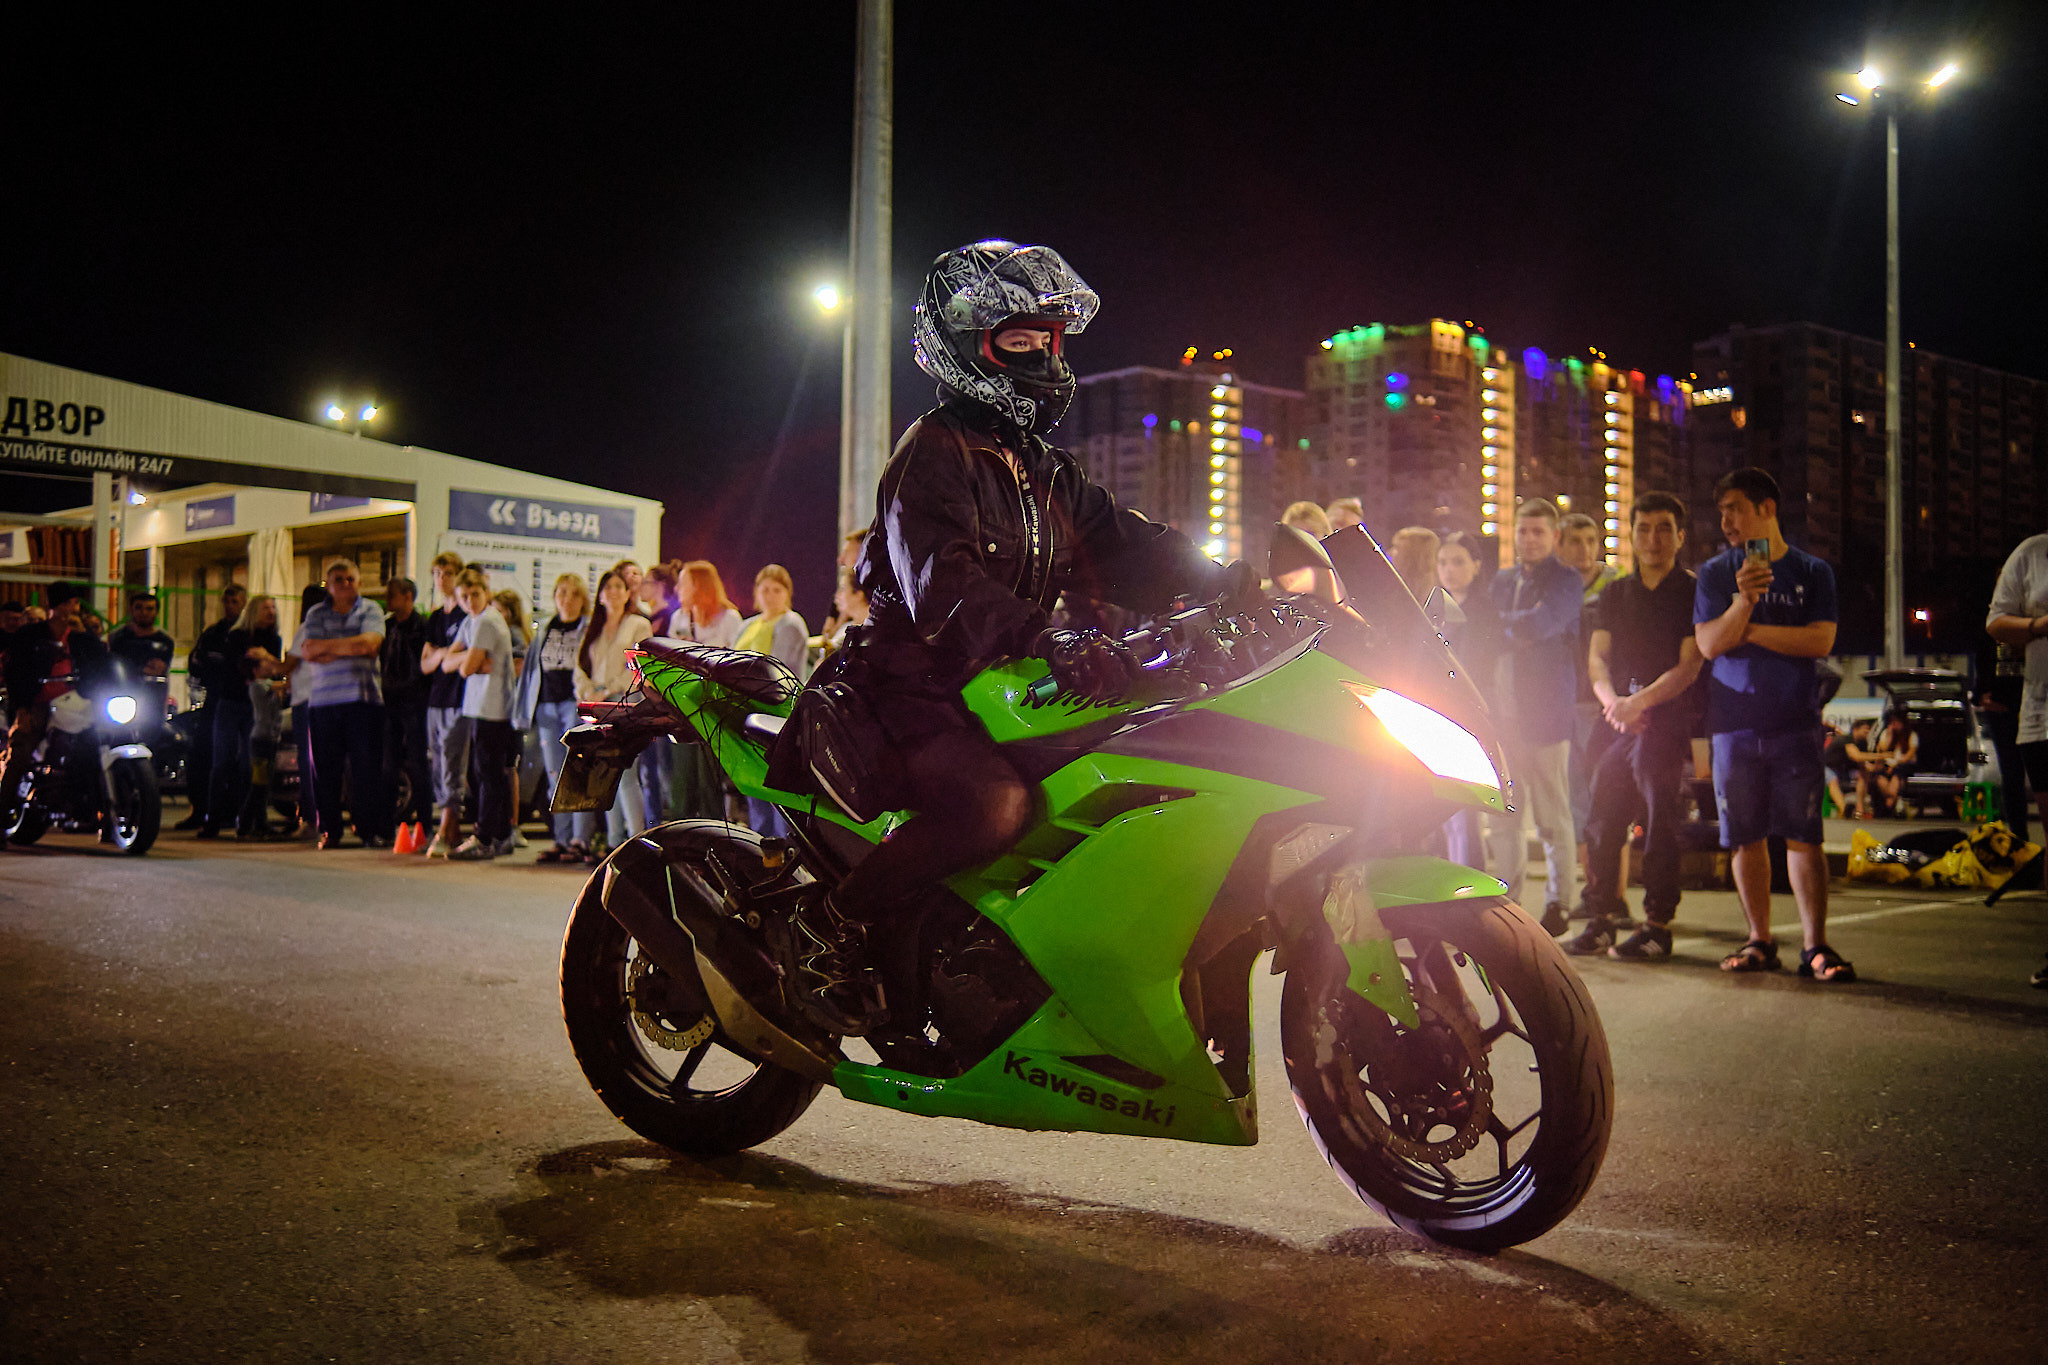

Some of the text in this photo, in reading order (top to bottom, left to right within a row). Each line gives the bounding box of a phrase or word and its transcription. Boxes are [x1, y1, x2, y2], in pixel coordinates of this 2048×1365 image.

[1, 396, 105, 436] ДВОР
[70, 449, 136, 471] ОНЛАЙН
[139, 456, 174, 475] 24/7
[526, 502, 600, 539] Въезд
[1025, 494, 1039, 534] Kawasaki
[1003, 1050, 1176, 1127] Kawasaki
